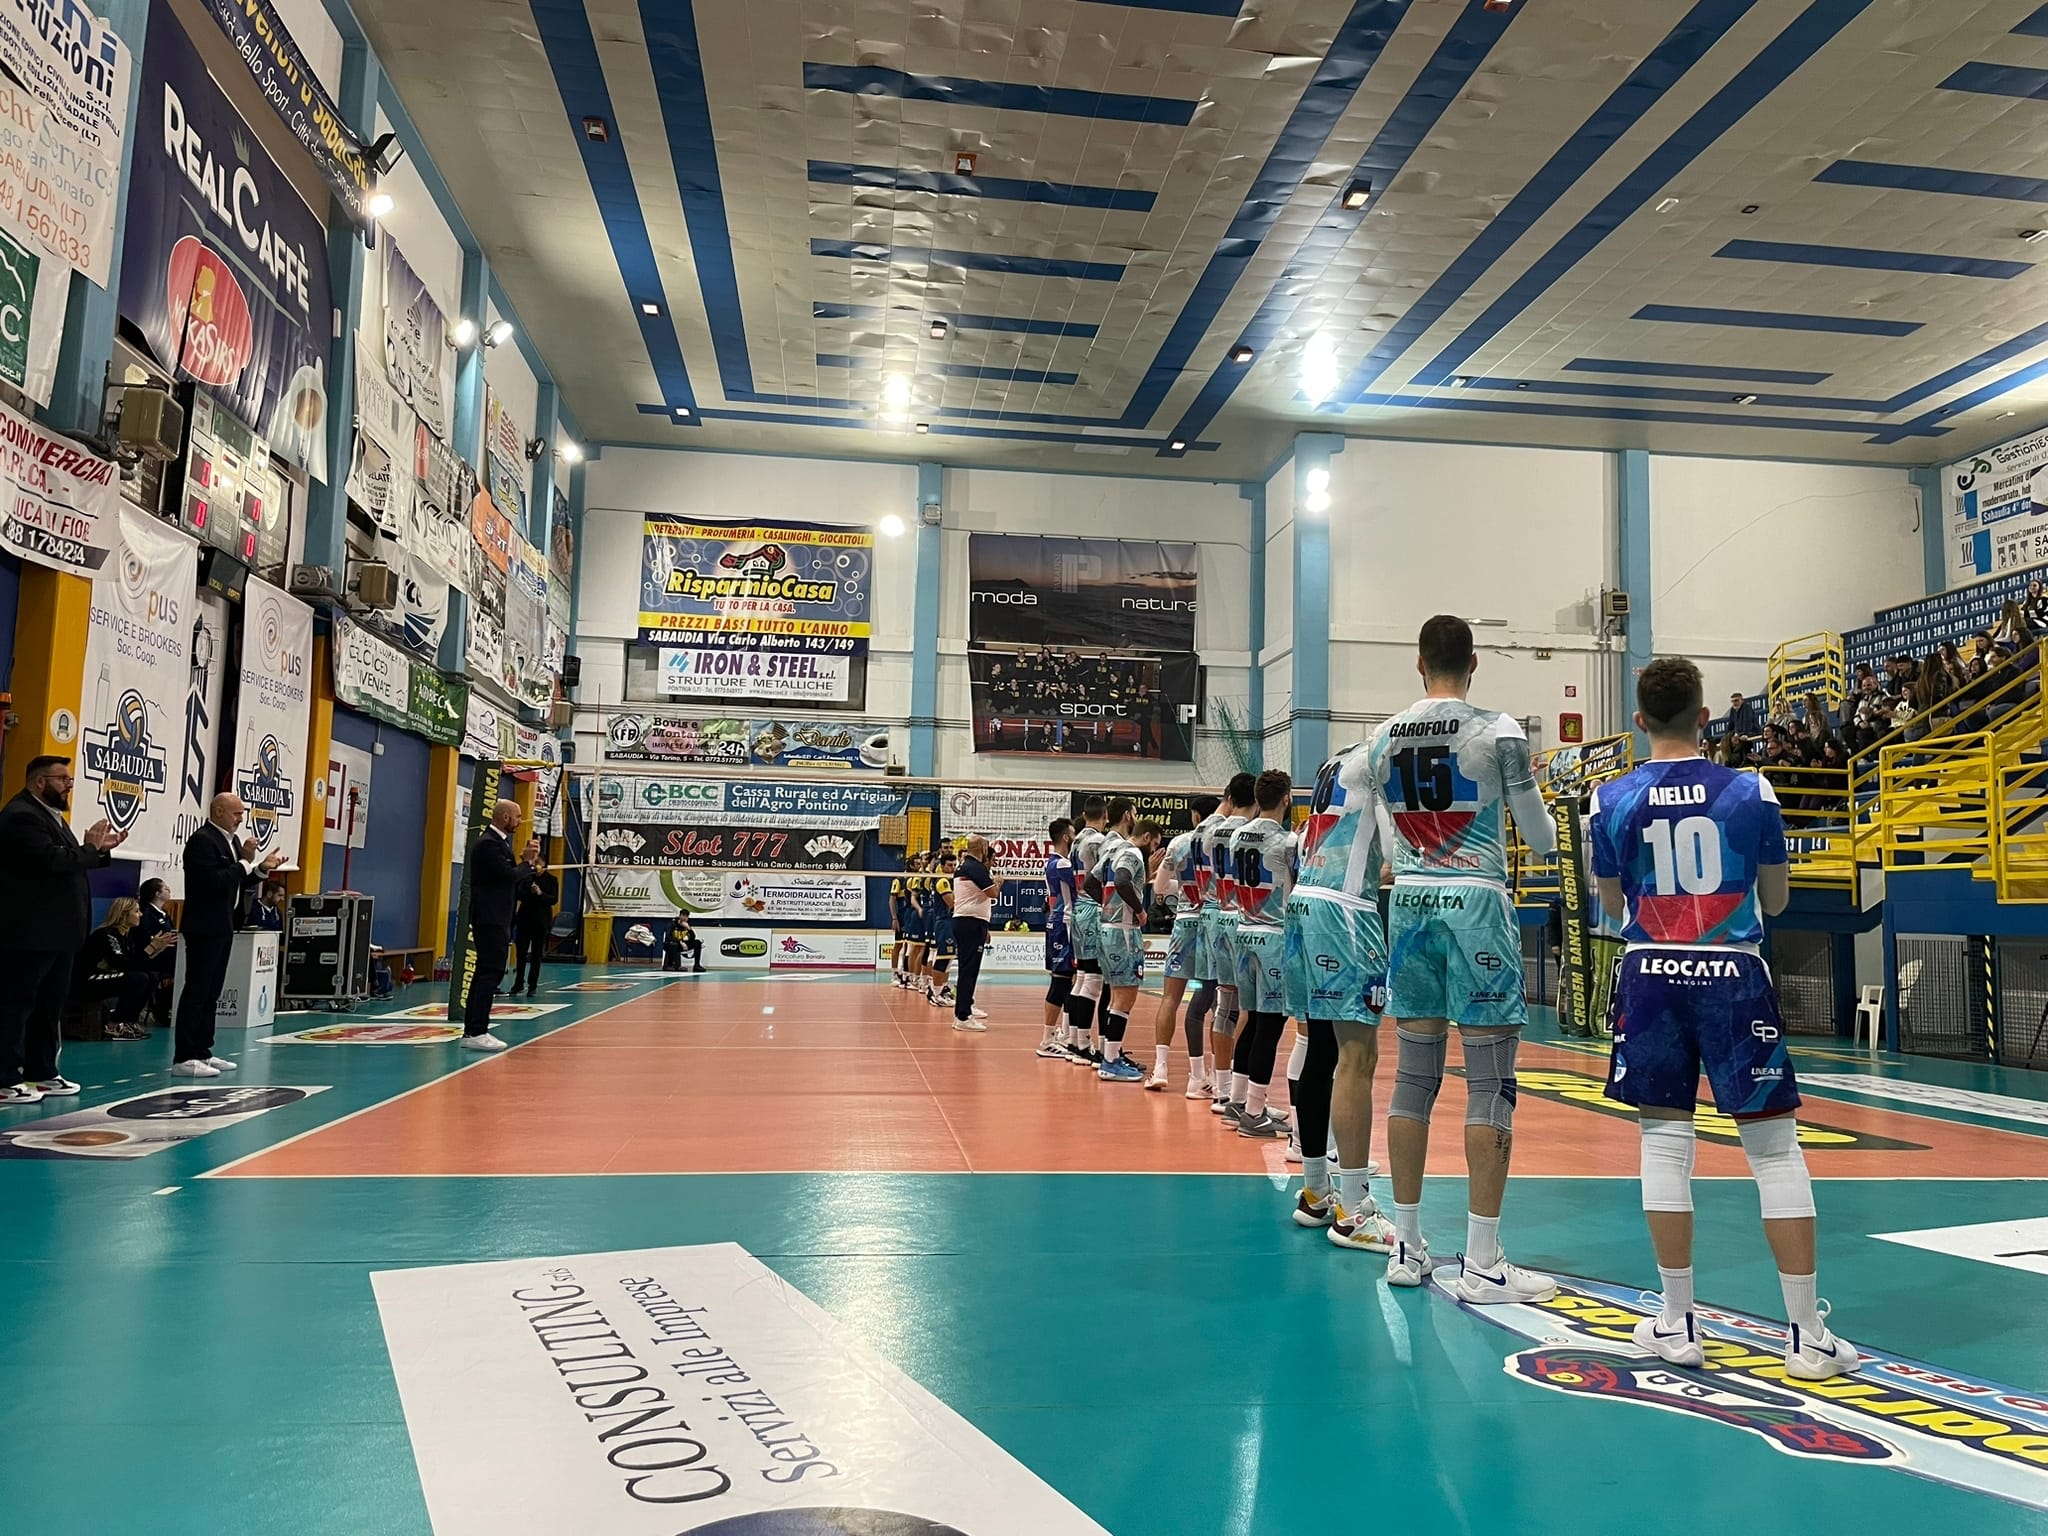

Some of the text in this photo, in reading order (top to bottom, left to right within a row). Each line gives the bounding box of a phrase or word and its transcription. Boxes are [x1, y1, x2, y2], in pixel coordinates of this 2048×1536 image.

[236, 32, 264, 74] dello
[263, 67, 290, 111] Sport
[701, 527, 755, 540] PROFUMERIA
[762, 530, 811, 543] CASALINGHI
[818, 533, 864, 545] GIOCATTOLI
[666, 571, 836, 601] RisparmioCasa
[759, 602, 771, 612] LA
[971, 590, 1038, 606] moda
[1121, 597, 1198, 612] natura
[90, 606, 129, 637] SERVICE
[138, 627, 182, 658] BROOKERS
[659, 615, 849, 636] PREZZI BASSI TUTTO L'ANNO
[116, 637, 134, 658] Soc.
[648, 630, 855, 652] SABAUDIA Via Carlo Alberto 143/149
[694, 652, 741, 676] IRON
[747, 654, 761, 677] &
[766, 655, 818, 679] STEEL
[241, 668, 269, 692] SERVICE
[667, 675, 833, 691] STRUTTURE METALLICHE
[1060, 702, 1128, 718] sport
[653, 717, 689, 729] Bovis
[1389, 719, 1459, 738] GAROFOLO
[609, 752, 644, 760] SABAUDIA
[719, 740, 745, 757] 24h
[94, 747, 156, 781] SABAUDIA
[1399, 744, 1454, 812] 15
[244, 782, 286, 808] SABAUDIA
[482, 768, 500, 820] BANCA
[668, 783, 719, 800] BCC
[732, 785, 771, 799] Cassa
[775, 786, 818, 800] Rurale
[822, 788, 839, 801] ed
[1648, 783, 1707, 806] AIELLO
[731, 797, 849, 812] dell'Agro Pontino
[1556, 804, 1573, 852] BANCA
[662, 829, 789, 858] Slot 777
[633, 855, 655, 866] Slot
[658, 856, 704, 866] Machine
[711, 859, 749, 868] Sabaudia
[756, 860, 769, 868] Via
[794, 861, 823, 870] Alberto
[1215, 843, 1232, 879] 9
[1642, 816, 1723, 896] 10
[1234, 848, 1261, 888] 18
[759, 886, 833, 899] TERMOIDRAULICA
[1563, 858, 1579, 912] CREDEM
[1394, 893, 1465, 910] LEOCATA
[996, 943, 1040, 953] FARMACIA
[1571, 918, 1584, 967] BANCA
[1639, 957, 1740, 977] LEOCATA
[1369, 984, 1386, 1007] 16
[1574, 971, 1586, 1027] CREDEM
[618, 1275, 839, 1486] Servizi alle Imprese
[510, 1286, 733, 1506] CONSULTING
